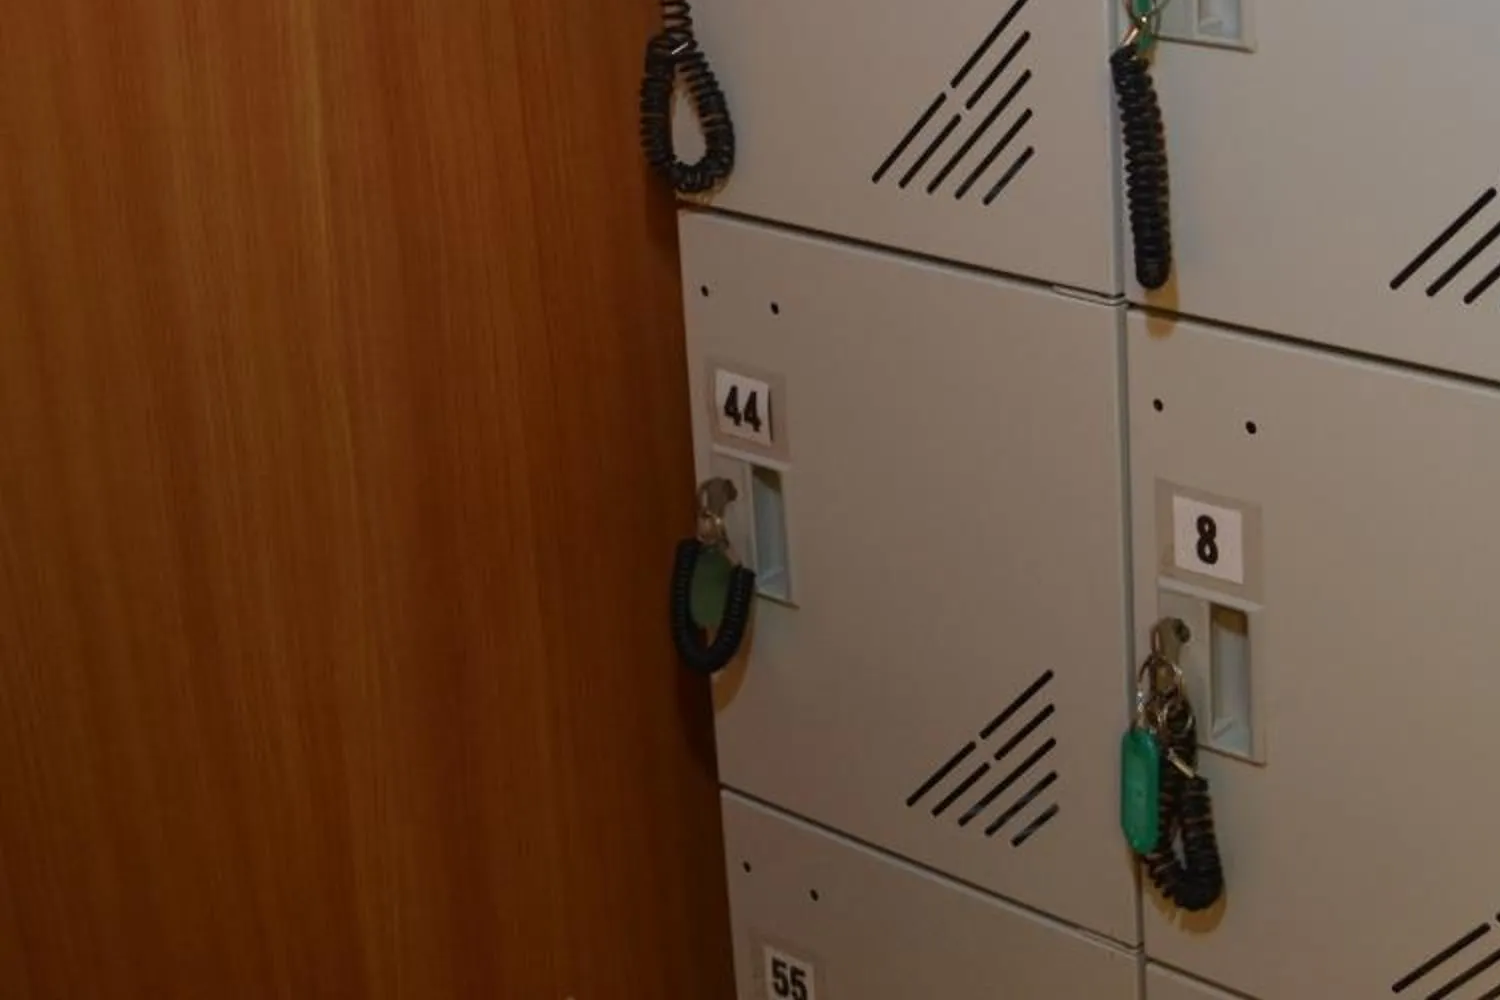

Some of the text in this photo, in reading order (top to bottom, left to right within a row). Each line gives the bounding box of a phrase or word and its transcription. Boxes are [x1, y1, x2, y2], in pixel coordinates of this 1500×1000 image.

[724, 385, 762, 433] 44
[1195, 514, 1219, 567] 8
[771, 957, 808, 1000] 55
